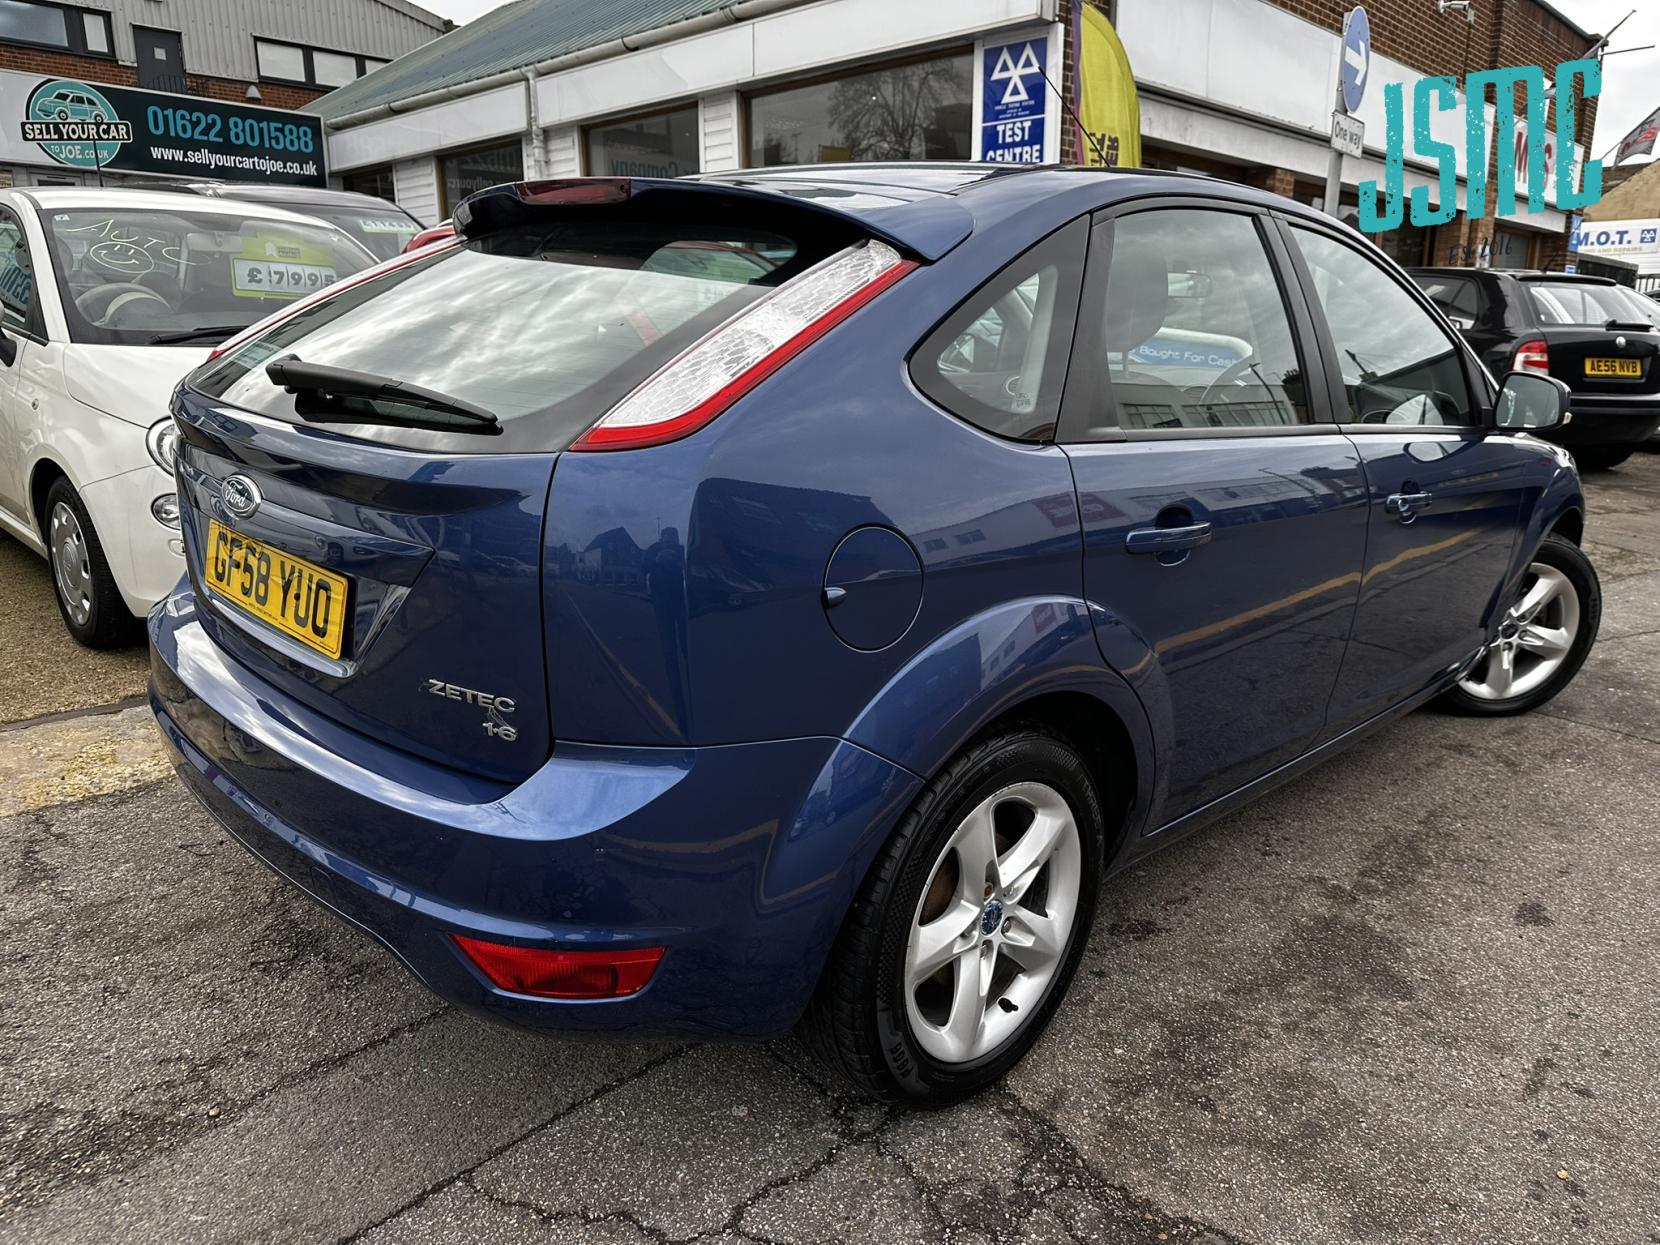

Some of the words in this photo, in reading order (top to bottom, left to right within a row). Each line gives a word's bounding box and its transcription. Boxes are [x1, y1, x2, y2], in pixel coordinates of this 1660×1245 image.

[25, 124, 58, 139] SELL
[60, 124, 97, 139] YOUR
[99, 125, 128, 140] CAR
[147, 106, 223, 143] 01622
[229, 117, 313, 153] 801588
[997, 121, 1031, 144] TEST
[150, 146, 318, 177] www.sellyourcartojoe.co.uk
[986, 145, 1041, 163] CENTRE
[1139, 345, 1179, 361] Bought
[1183, 352, 1205, 362] For
[1590, 360, 1617, 372] AE56
[1619, 361, 1637, 373] NVB
[224, 480, 248, 507] Ford
[214, 531, 270, 607] GF58
[280, 561, 331, 639] YUO
[429, 680, 515, 712] ZETEC
